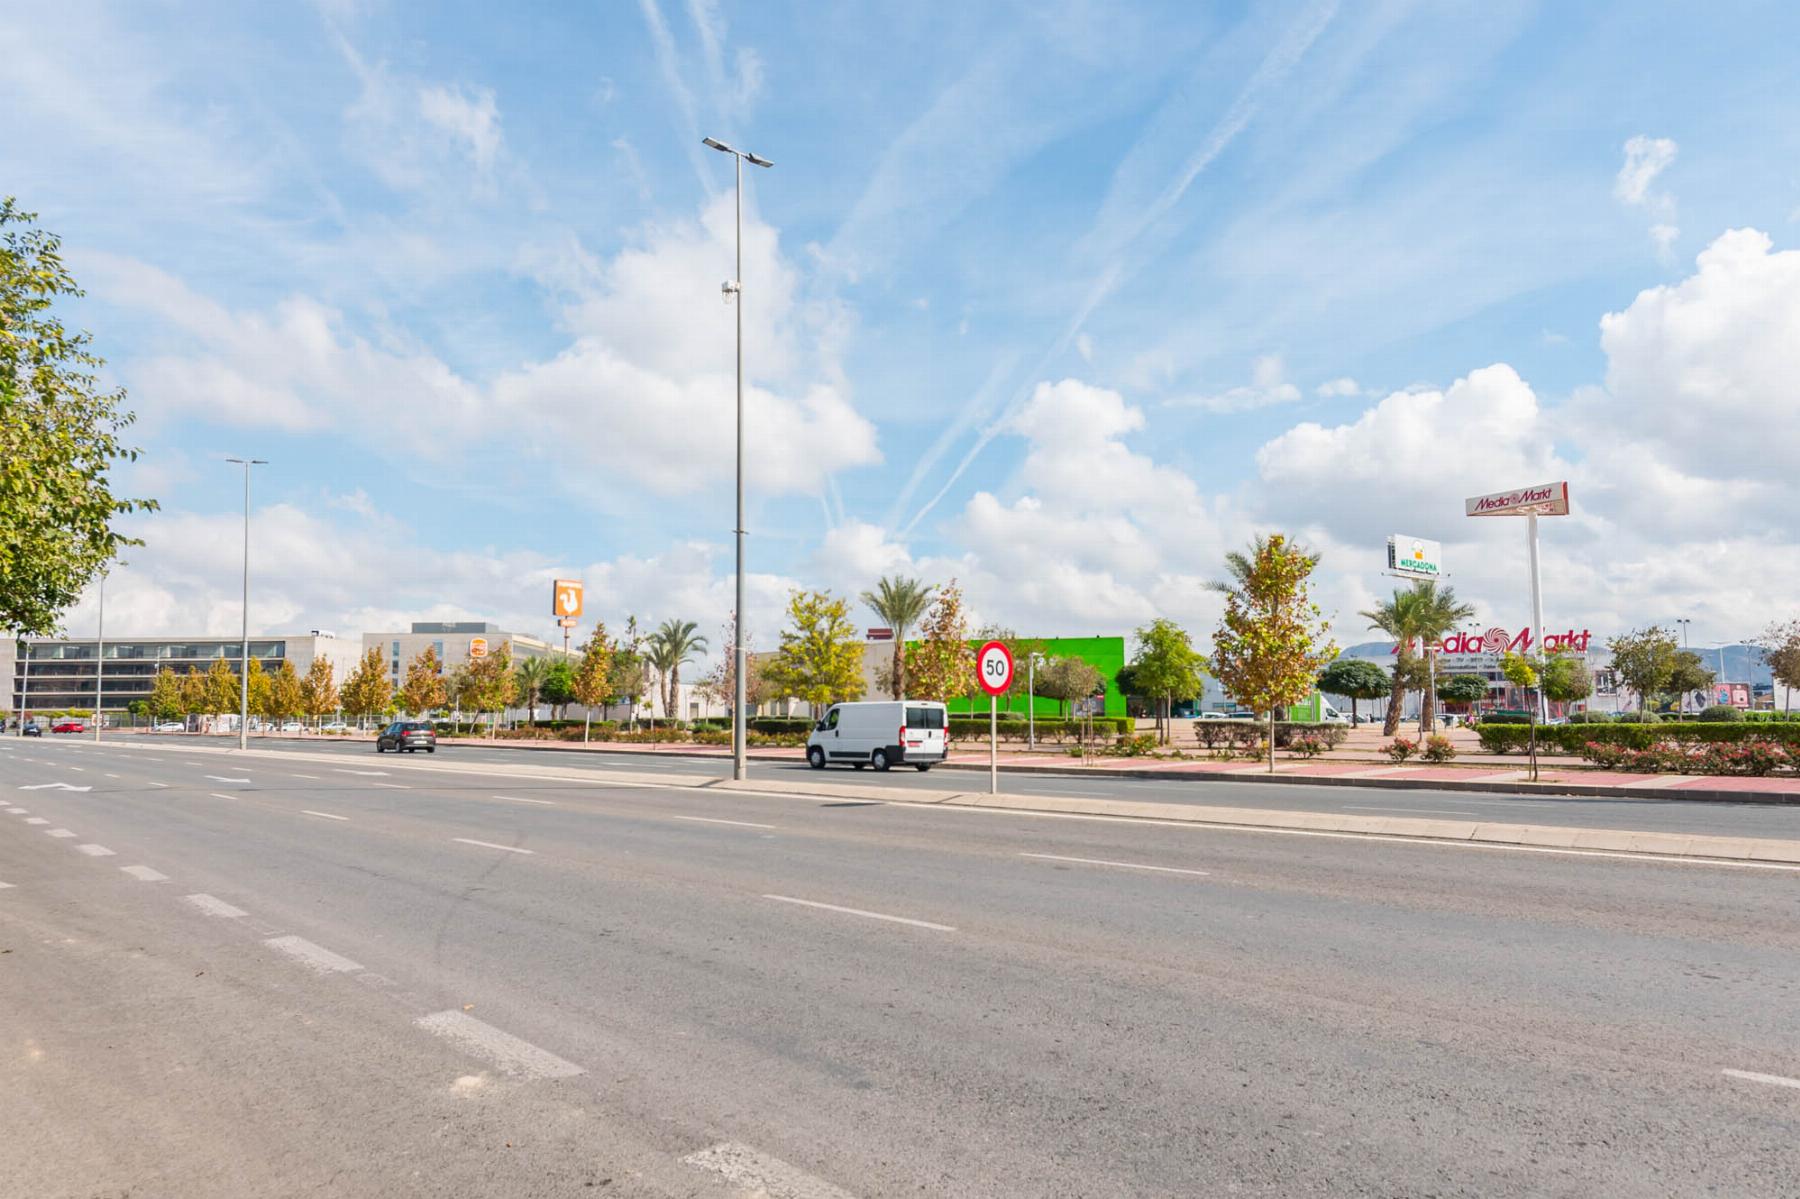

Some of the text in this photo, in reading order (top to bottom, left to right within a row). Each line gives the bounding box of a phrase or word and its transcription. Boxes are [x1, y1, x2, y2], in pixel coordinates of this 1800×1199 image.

[1474, 488, 1552, 512] Media Markt
[1400, 558, 1438, 572] MERCADONA
[1391, 631, 1483, 654] dia
[986, 659, 1005, 676] 50
